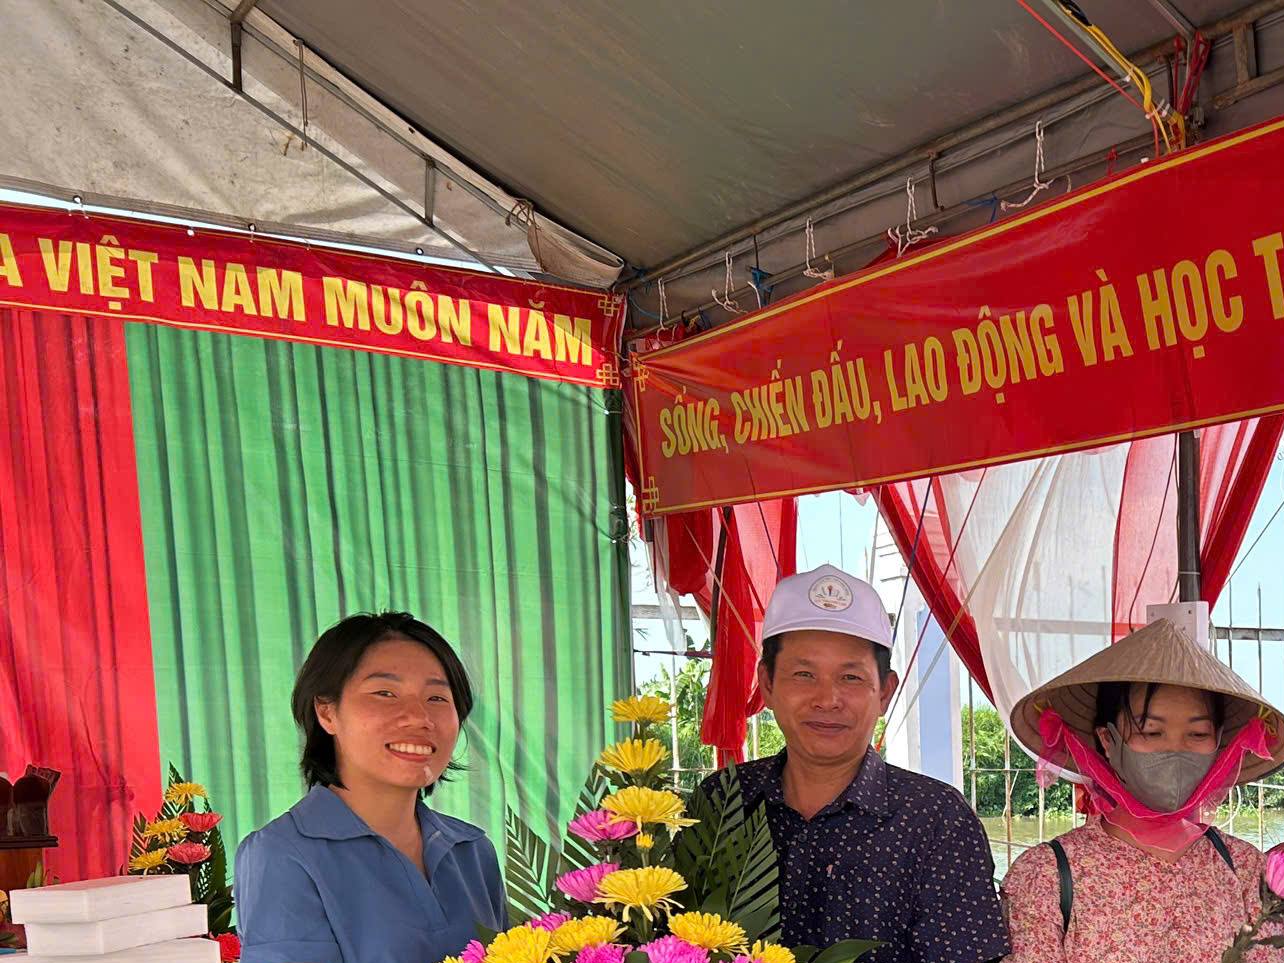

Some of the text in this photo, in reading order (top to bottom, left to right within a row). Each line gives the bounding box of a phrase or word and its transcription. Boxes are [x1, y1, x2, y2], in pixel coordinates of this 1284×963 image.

[38, 235, 159, 310] VIỆT
[177, 256, 306, 322] NAM
[322, 277, 472, 347] MUÔN
[487, 296, 593, 366] NĂM
[659, 386, 729, 458] SỐNG,
[730, 359, 810, 444] CHIẾN
[810, 339, 882, 424] ĐẤU,
[883, 336, 948, 412] LAO
[952, 305, 1064, 404] ĐỘNG
[1067, 268, 1134, 367] VÀ
[1136, 249, 1244, 359] HỌC
